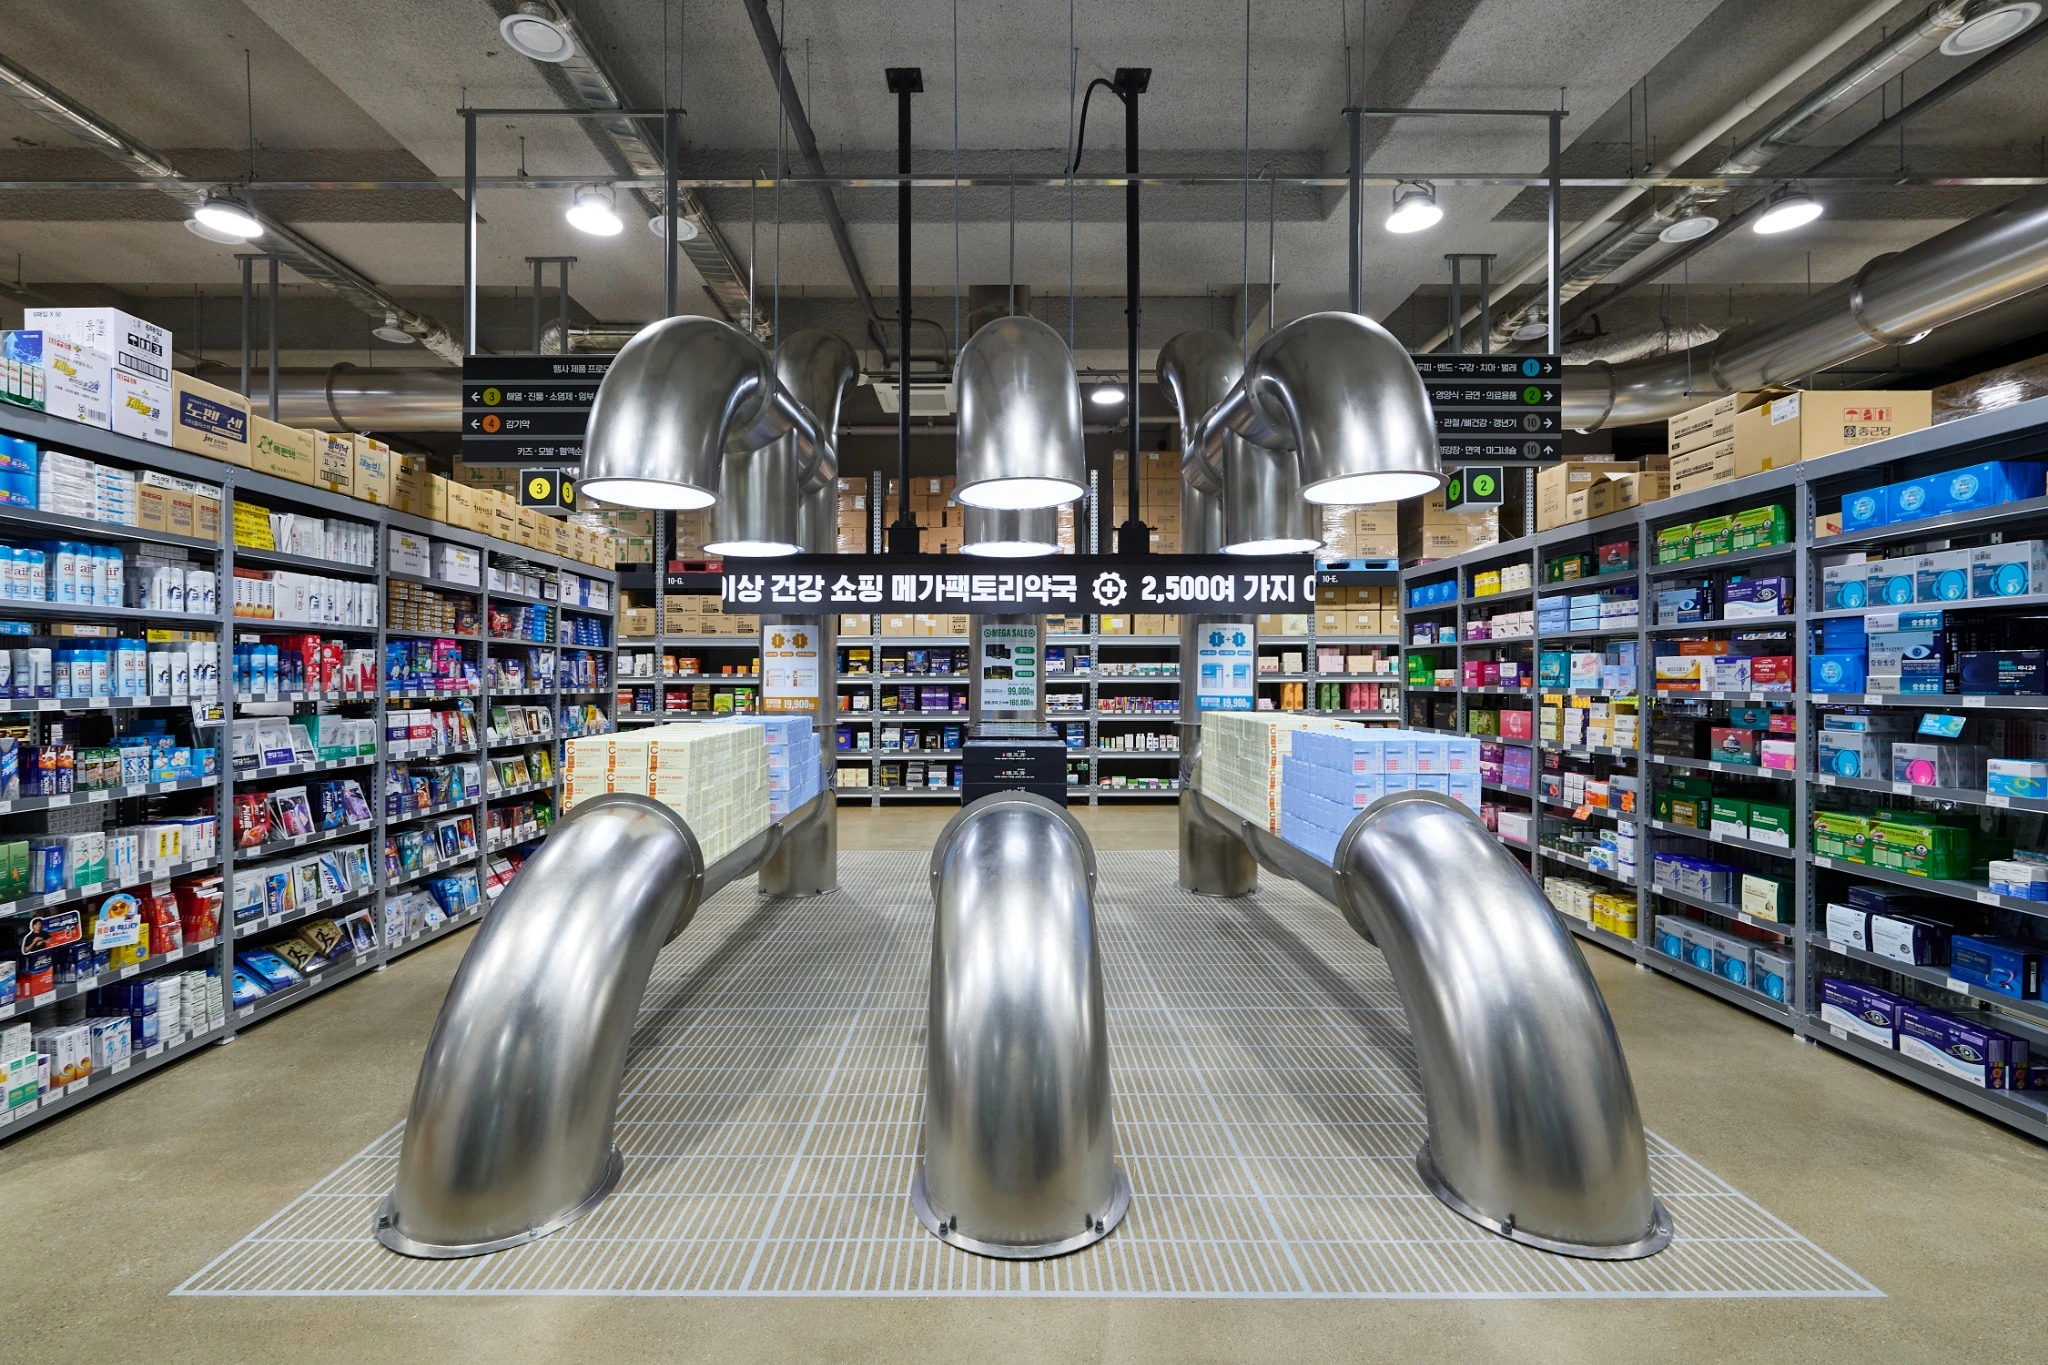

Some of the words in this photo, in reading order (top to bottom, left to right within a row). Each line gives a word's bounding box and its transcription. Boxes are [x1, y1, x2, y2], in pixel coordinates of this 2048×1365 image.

[552, 364, 570, 373] 행사
[570, 364, 586, 373] 제품
[1437, 363, 1453, 372] 밴드
[1459, 363, 1475, 372] 구강
[1480, 363, 1496, 372] 치아
[1501, 363, 1517, 372] 벌레
[489, 392, 495, 401] 3
[506, 392, 522, 400] 해열
[528, 392, 544, 400] 진통
[550, 392, 573, 400] 소염제
[1436, 391, 1459, 400] 영양식
[1465, 391, 1481, 400] 금연
[1486, 391, 1517, 400] 의료용품
[1529, 391, 1535, 400] 2
[488, 420, 494, 428] 4
[506, 420, 530, 429] 감기약
[1493, 418, 1517, 427] 갱년기
[1527, 418, 1536, 428] 10
[1858, 426, 1892, 436] 종근당
[517, 448, 533, 456] 키즈
[538, 448, 554, 456] 모발
[1465, 446, 1480, 455] 면역
[1486, 446, 1517, 455] 마그네슘
[1527, 446, 1536, 455] 10
[536, 483, 543, 494] 3
[1452, 484, 1457, 496] 2
[1481, 480, 1487, 491] 2
[566, 488, 570, 498] 3
[770, 575, 825, 602] 건강
[830, 575, 883, 602] 쇼핑
[892, 574, 1078, 603] 메가팩토리약국
[1141, 575, 1234, 604] 2,500여
[1243, 575, 1295, 602] 가지
[992, 629, 1011, 637] MEGA
[1012, 629, 1028, 637] SALE
